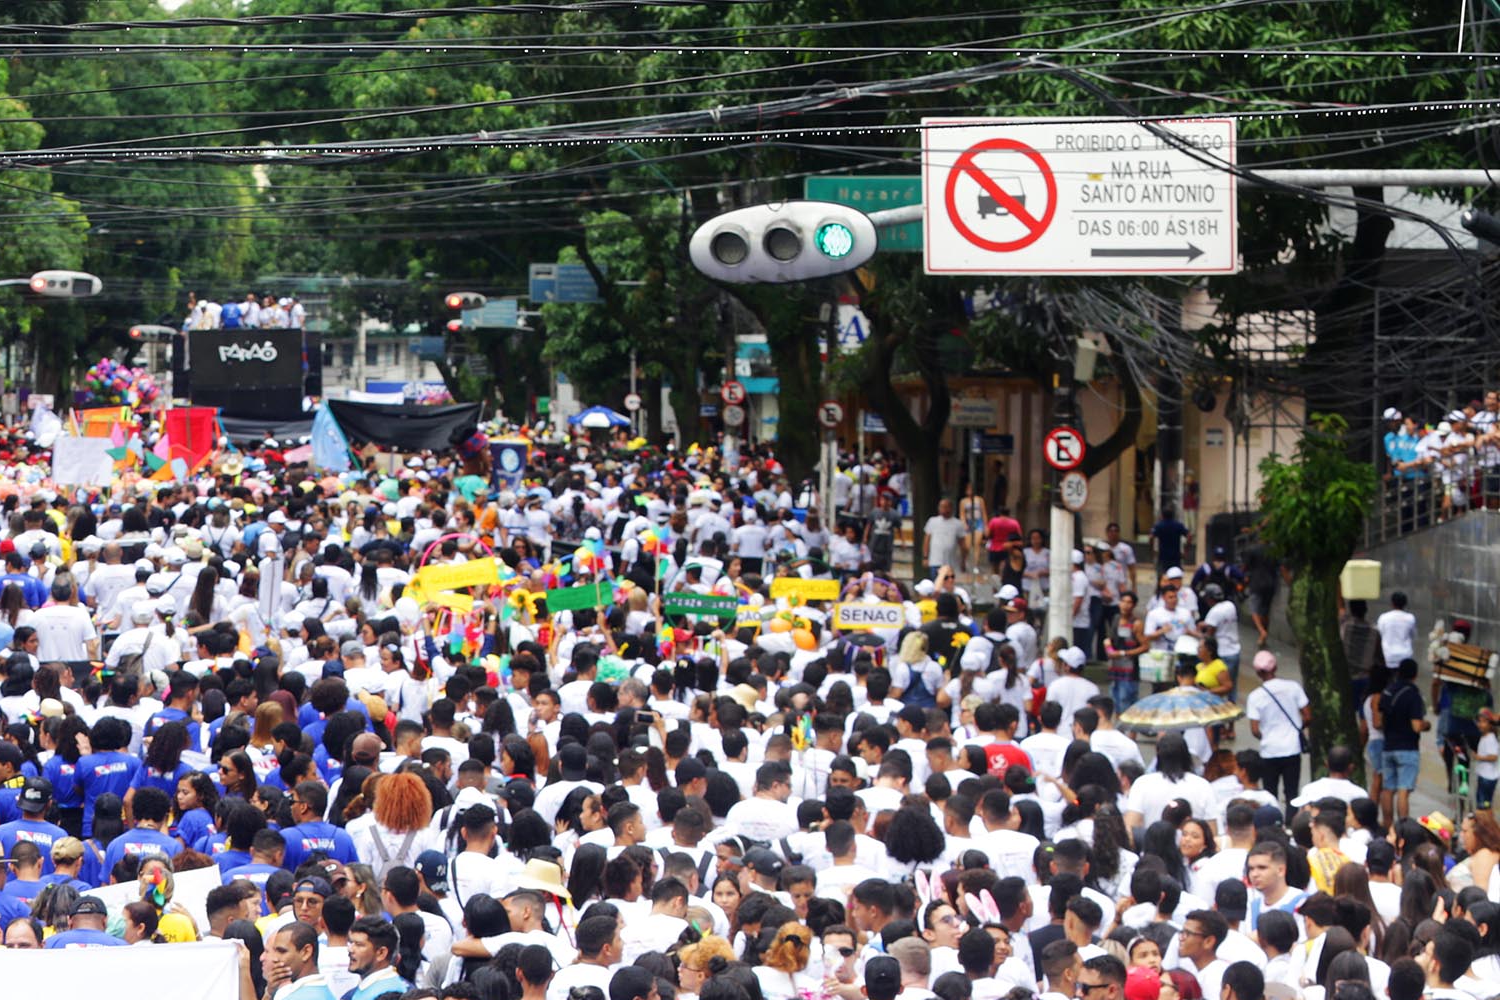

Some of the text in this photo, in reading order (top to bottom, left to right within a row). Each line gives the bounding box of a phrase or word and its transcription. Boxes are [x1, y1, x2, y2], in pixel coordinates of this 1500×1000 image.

[1055, 135, 1127, 151] PROIBIDO
[1131, 135, 1142, 151] O
[1112, 162, 1172, 178] NA RUA
[1080, 184, 1215, 203] SANTO ANTONIO
[1079, 221, 1111, 236] DAS
[1117, 221, 1159, 236] 06:00
[1056, 436, 1071, 461] E
[1066, 480, 1083, 497] 50
[841, 608, 898, 623] SENAC
